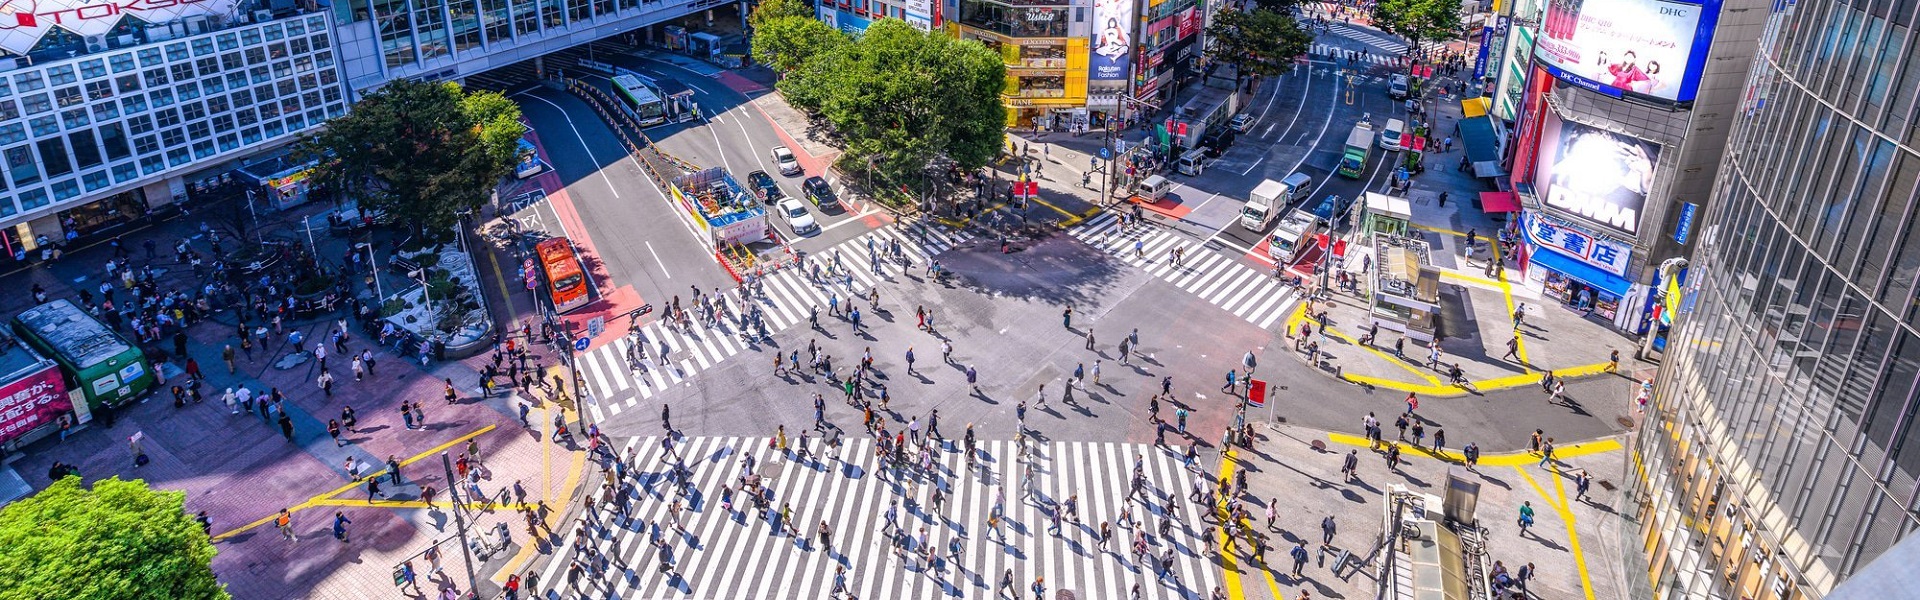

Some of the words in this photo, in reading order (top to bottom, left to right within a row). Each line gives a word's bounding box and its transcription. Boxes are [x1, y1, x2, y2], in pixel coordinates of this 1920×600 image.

[1580, 14, 1596, 24] DHC
[1659, 7, 1687, 17] DHC
[1560, 71, 1574, 82] DHC
[1573, 77, 1600, 91] Channel
[1547, 183, 1636, 233] DMM
